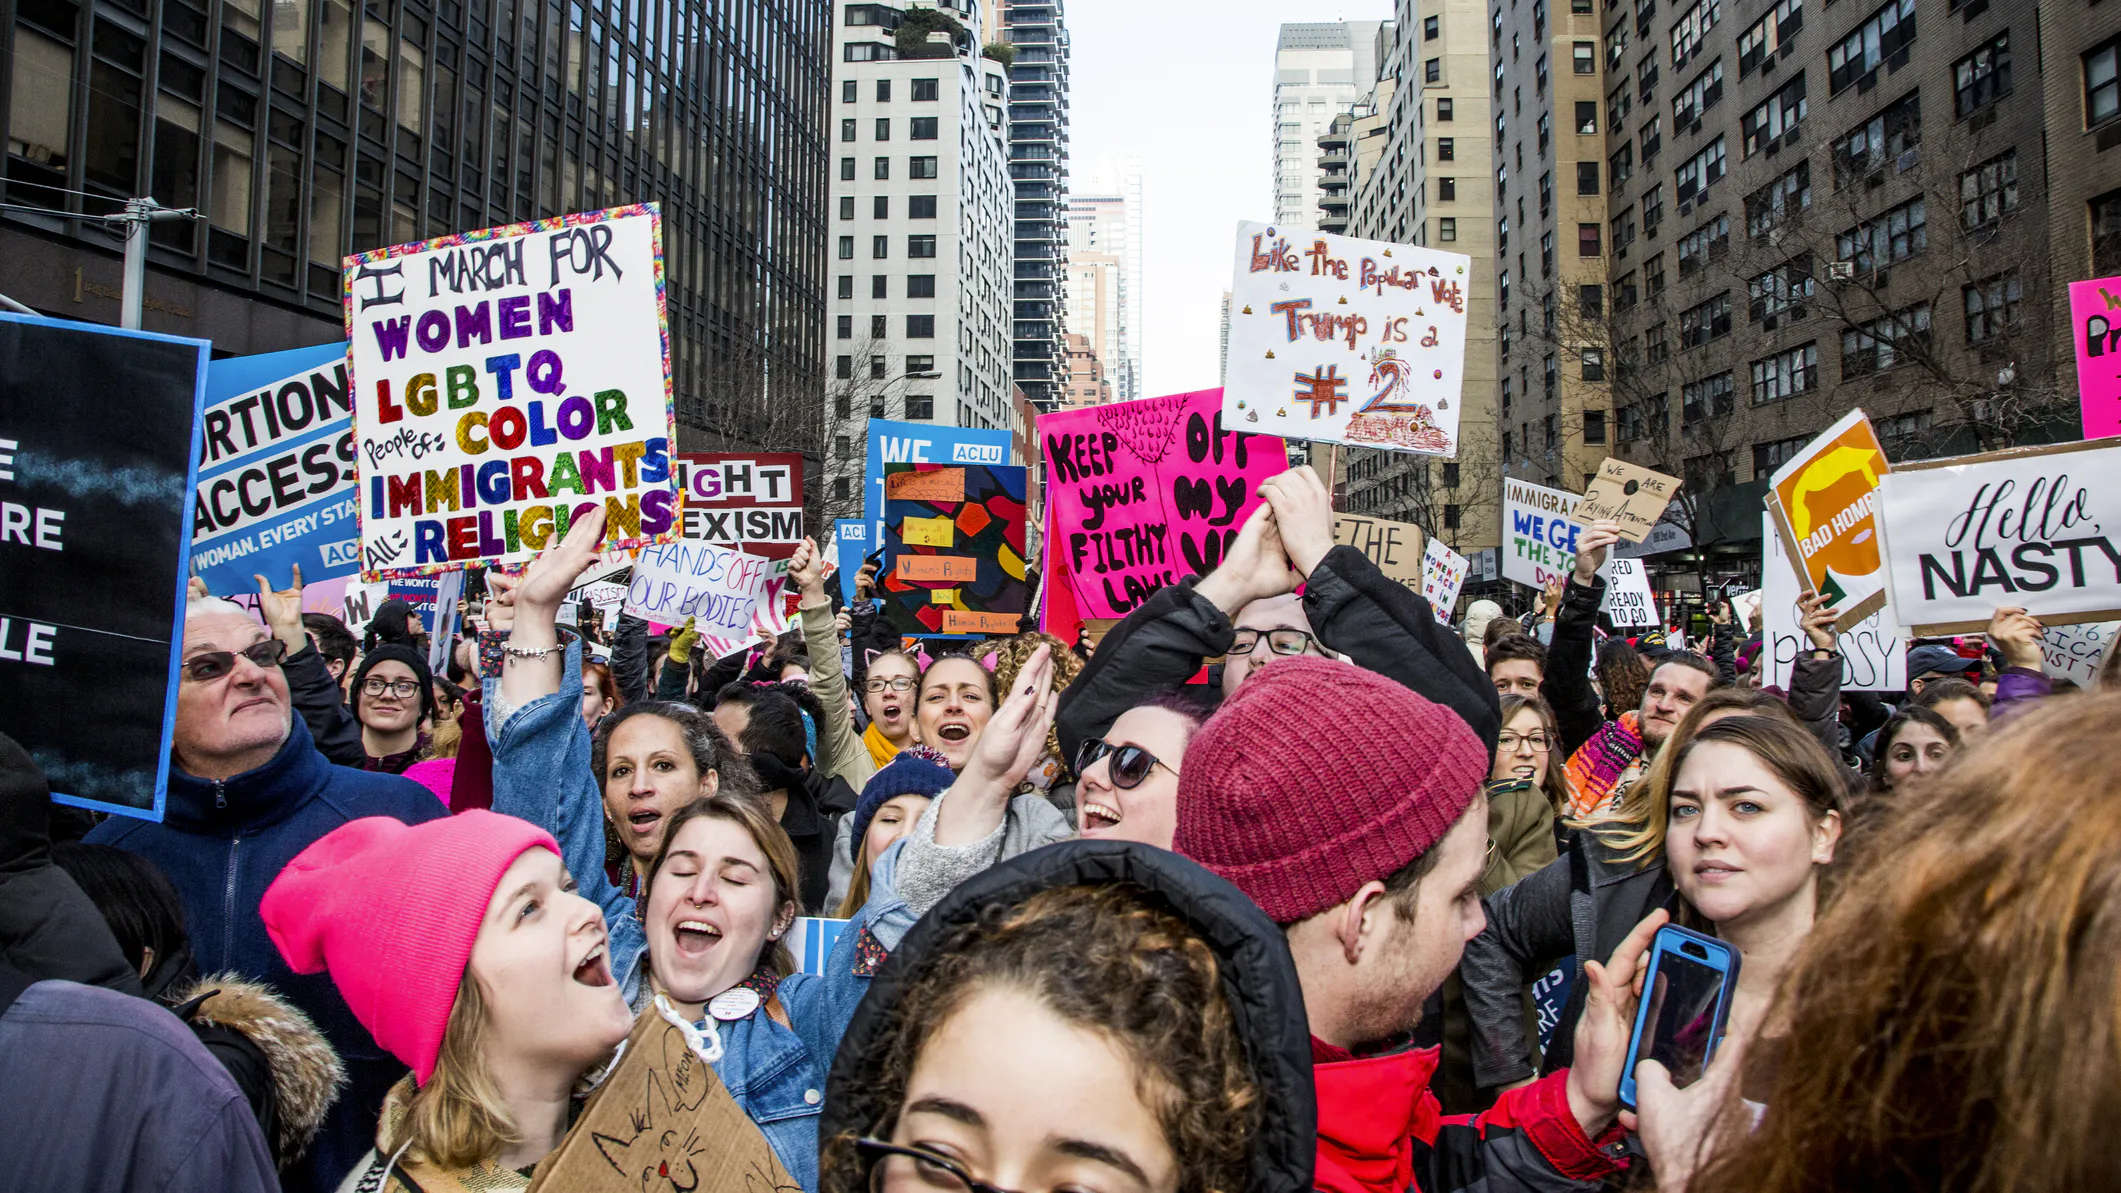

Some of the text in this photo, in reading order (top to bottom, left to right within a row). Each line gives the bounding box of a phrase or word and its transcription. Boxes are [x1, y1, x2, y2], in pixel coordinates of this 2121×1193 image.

[354, 224, 623, 313] I MARCH FOR
[1249, 232, 1300, 274] Like
[1359, 256, 1426, 297] Popular
[1430, 277, 1465, 314] Vote
[372, 288, 574, 362] WOMEN
[1269, 297, 1440, 351] Trump is a
[376, 349, 568, 425] LGBTQ
[199, 363, 351, 468] RTION
[455, 388, 634, 456] COLOR
[363, 427, 418, 470] People
[880, 435, 932, 464] WE
[956, 445, 1000, 462] ACLU
[1047, 431, 1118, 484] KEEP
[370, 437, 671, 521] IMMIGRANTS
[679, 463, 786, 498] IGHT
[1173, 475, 1247, 527] MY
[1606, 463, 1666, 492] WE ARE
[194, 496, 357, 571] WOMAN. EVERY STA
[1513, 509, 1544, 542] WE
[1800, 524, 1833, 559] BAD
[1830, 485, 1881, 537] HOMB
[1945, 474, 2101, 551] Hello,
[1069, 522, 1167, 574] FILTHY
[1341, 518, 1403, 566] THE
[1445, 550, 1452, 559] A
[1513, 536, 1551, 566] THE
[390, 579, 405, 587] WE
[726, 557, 766, 596] OFF
[1425, 552, 1461, 583] WOMEN'S
[1426, 584, 1434, 593] IS
[1428, 567, 1455, 590] PLACE
[1918, 535, 2121, 601] NASTY
[629, 574, 678, 613] OUR
[679, 586, 755, 630] BODIES
[1609, 592, 1645, 607] READY
[1611, 608, 1647, 624] TO GO
